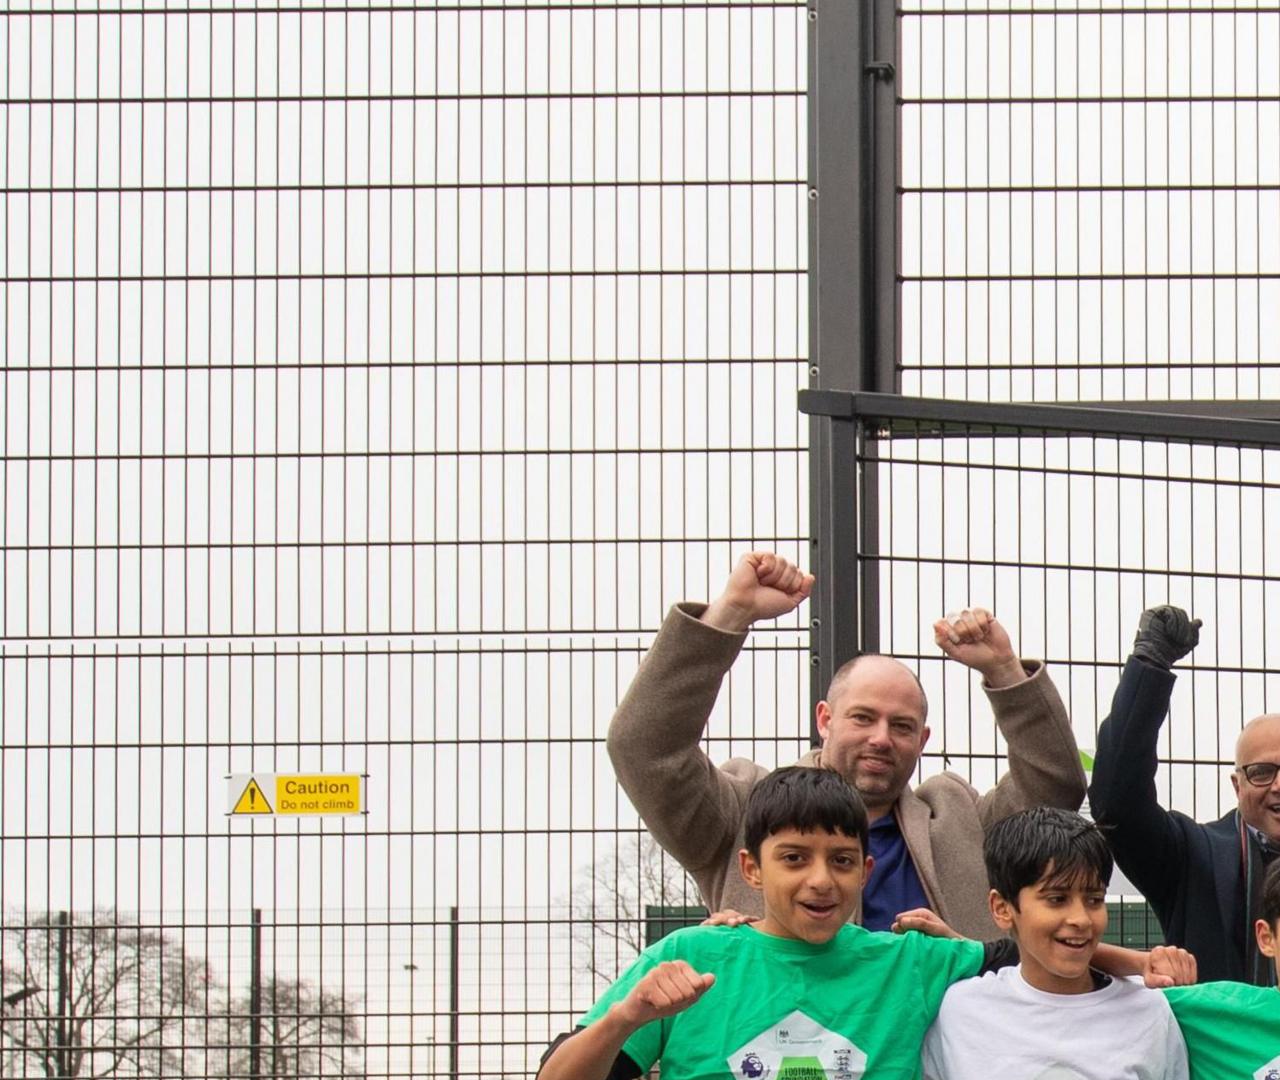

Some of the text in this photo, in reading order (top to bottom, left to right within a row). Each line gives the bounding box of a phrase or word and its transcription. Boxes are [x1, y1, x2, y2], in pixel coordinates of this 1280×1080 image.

[285, 780, 349, 794] Caution
[281, 799, 354, 809] Do not climb
[784, 1067, 817, 1076] FOOTBALL
